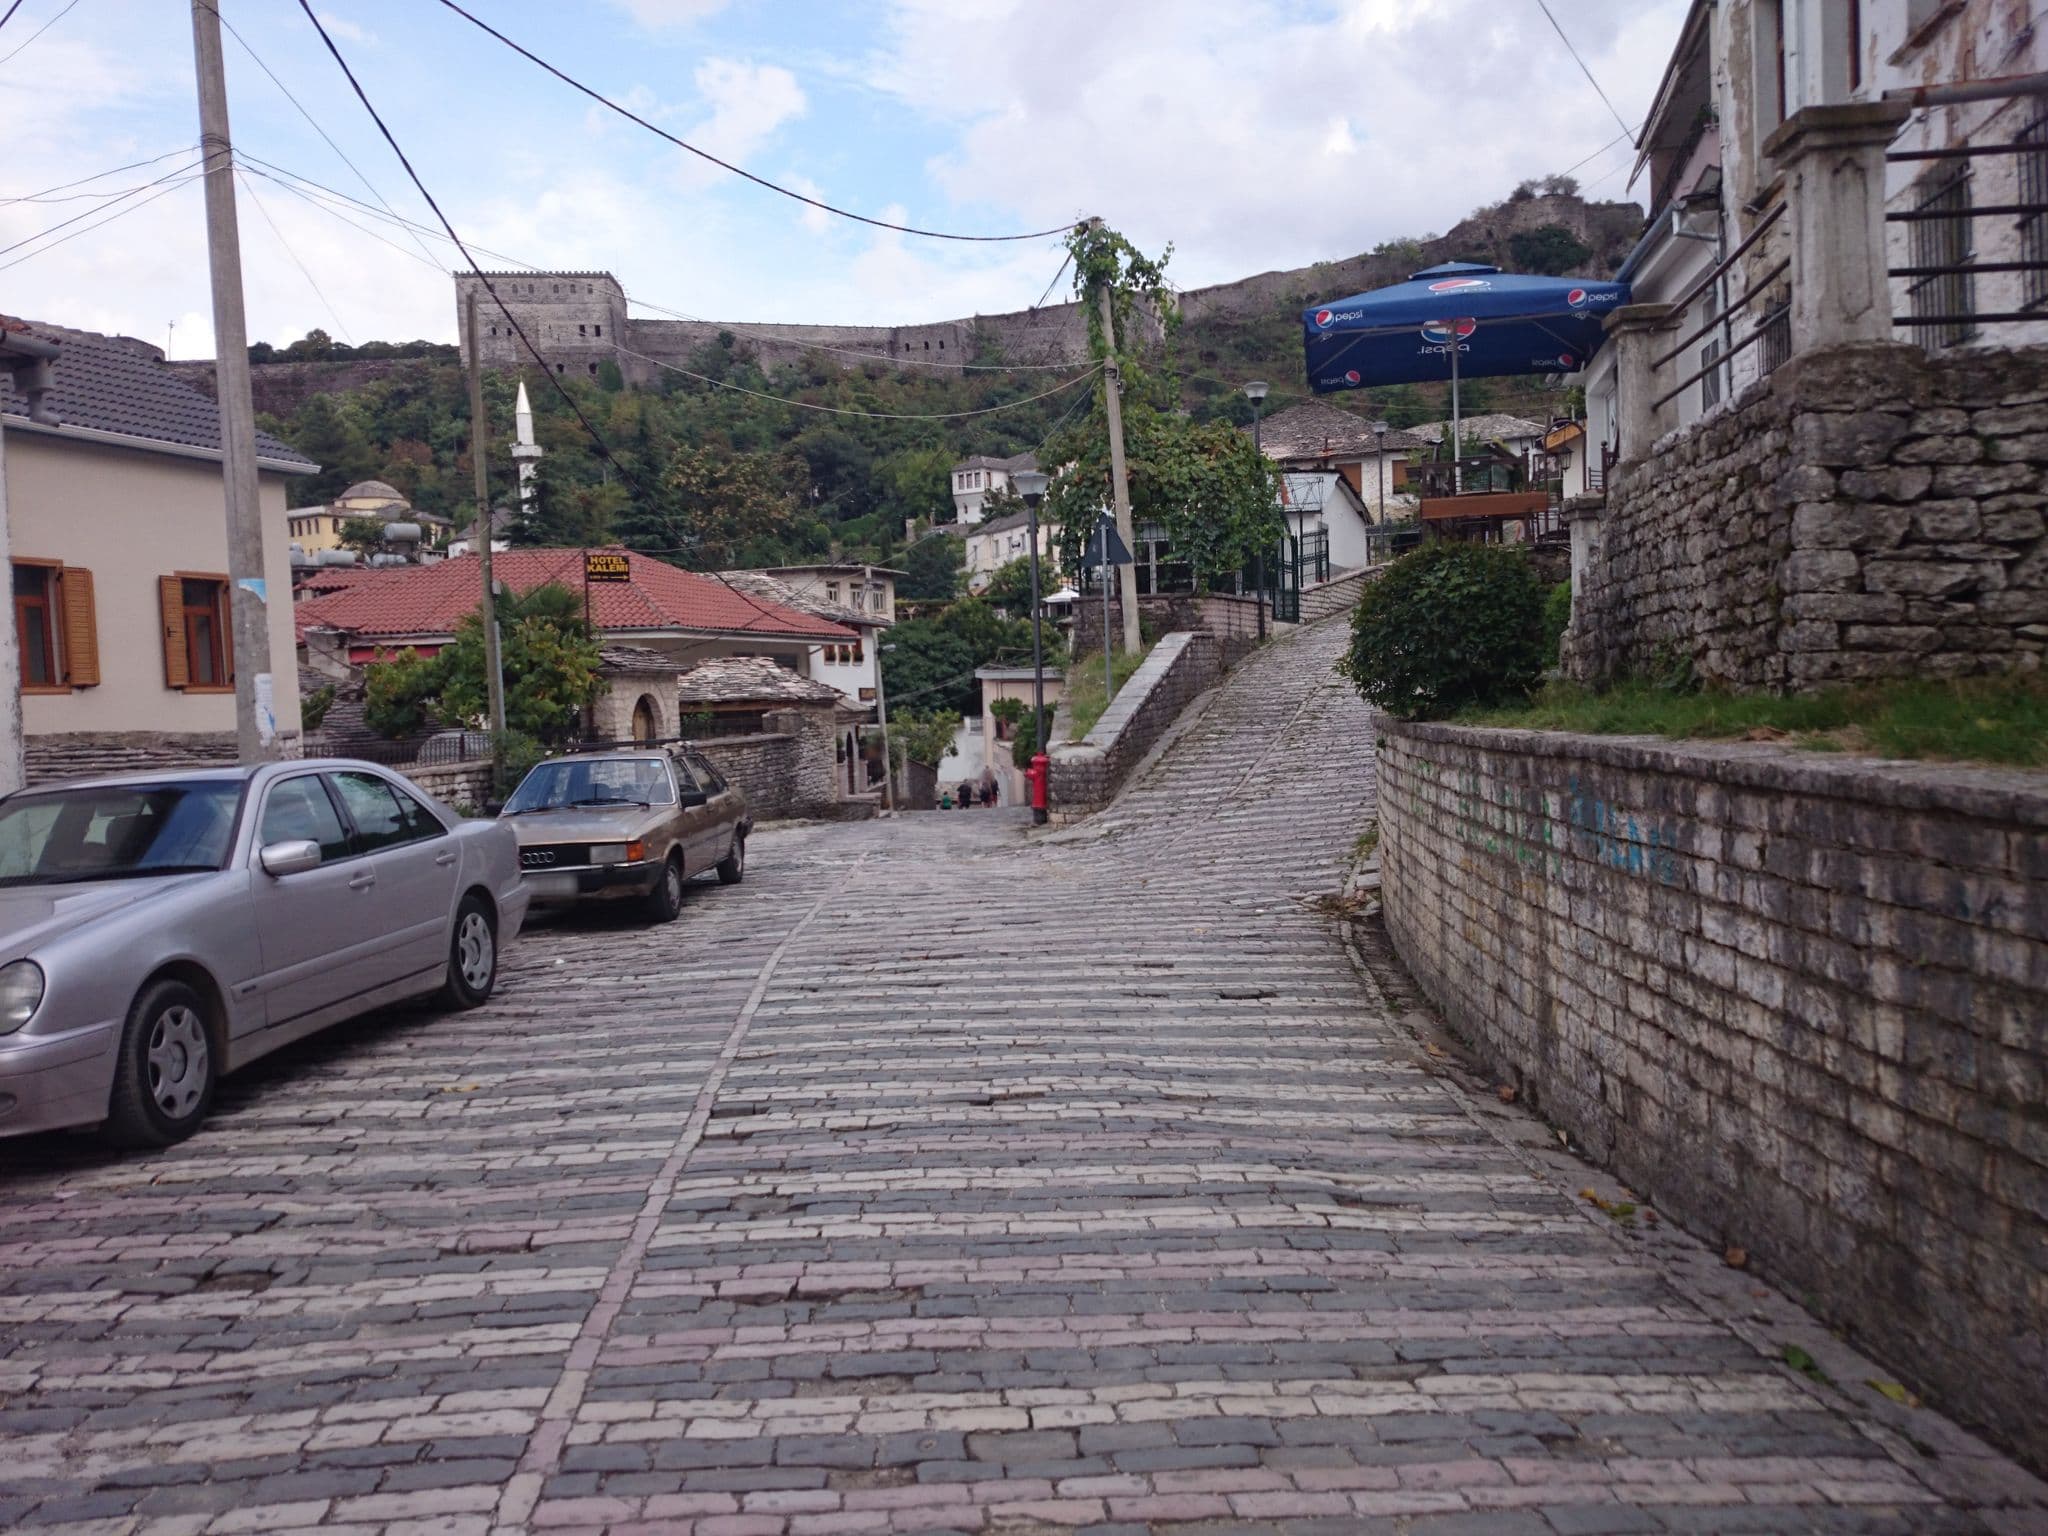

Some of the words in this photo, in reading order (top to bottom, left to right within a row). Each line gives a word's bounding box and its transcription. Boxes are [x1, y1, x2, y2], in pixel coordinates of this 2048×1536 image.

[1588, 292, 1618, 303] pepsi
[1335, 309, 1363, 323] pepsi
[590, 556, 625, 564] HOTEL
[587, 564, 628, 572] KALEMI
